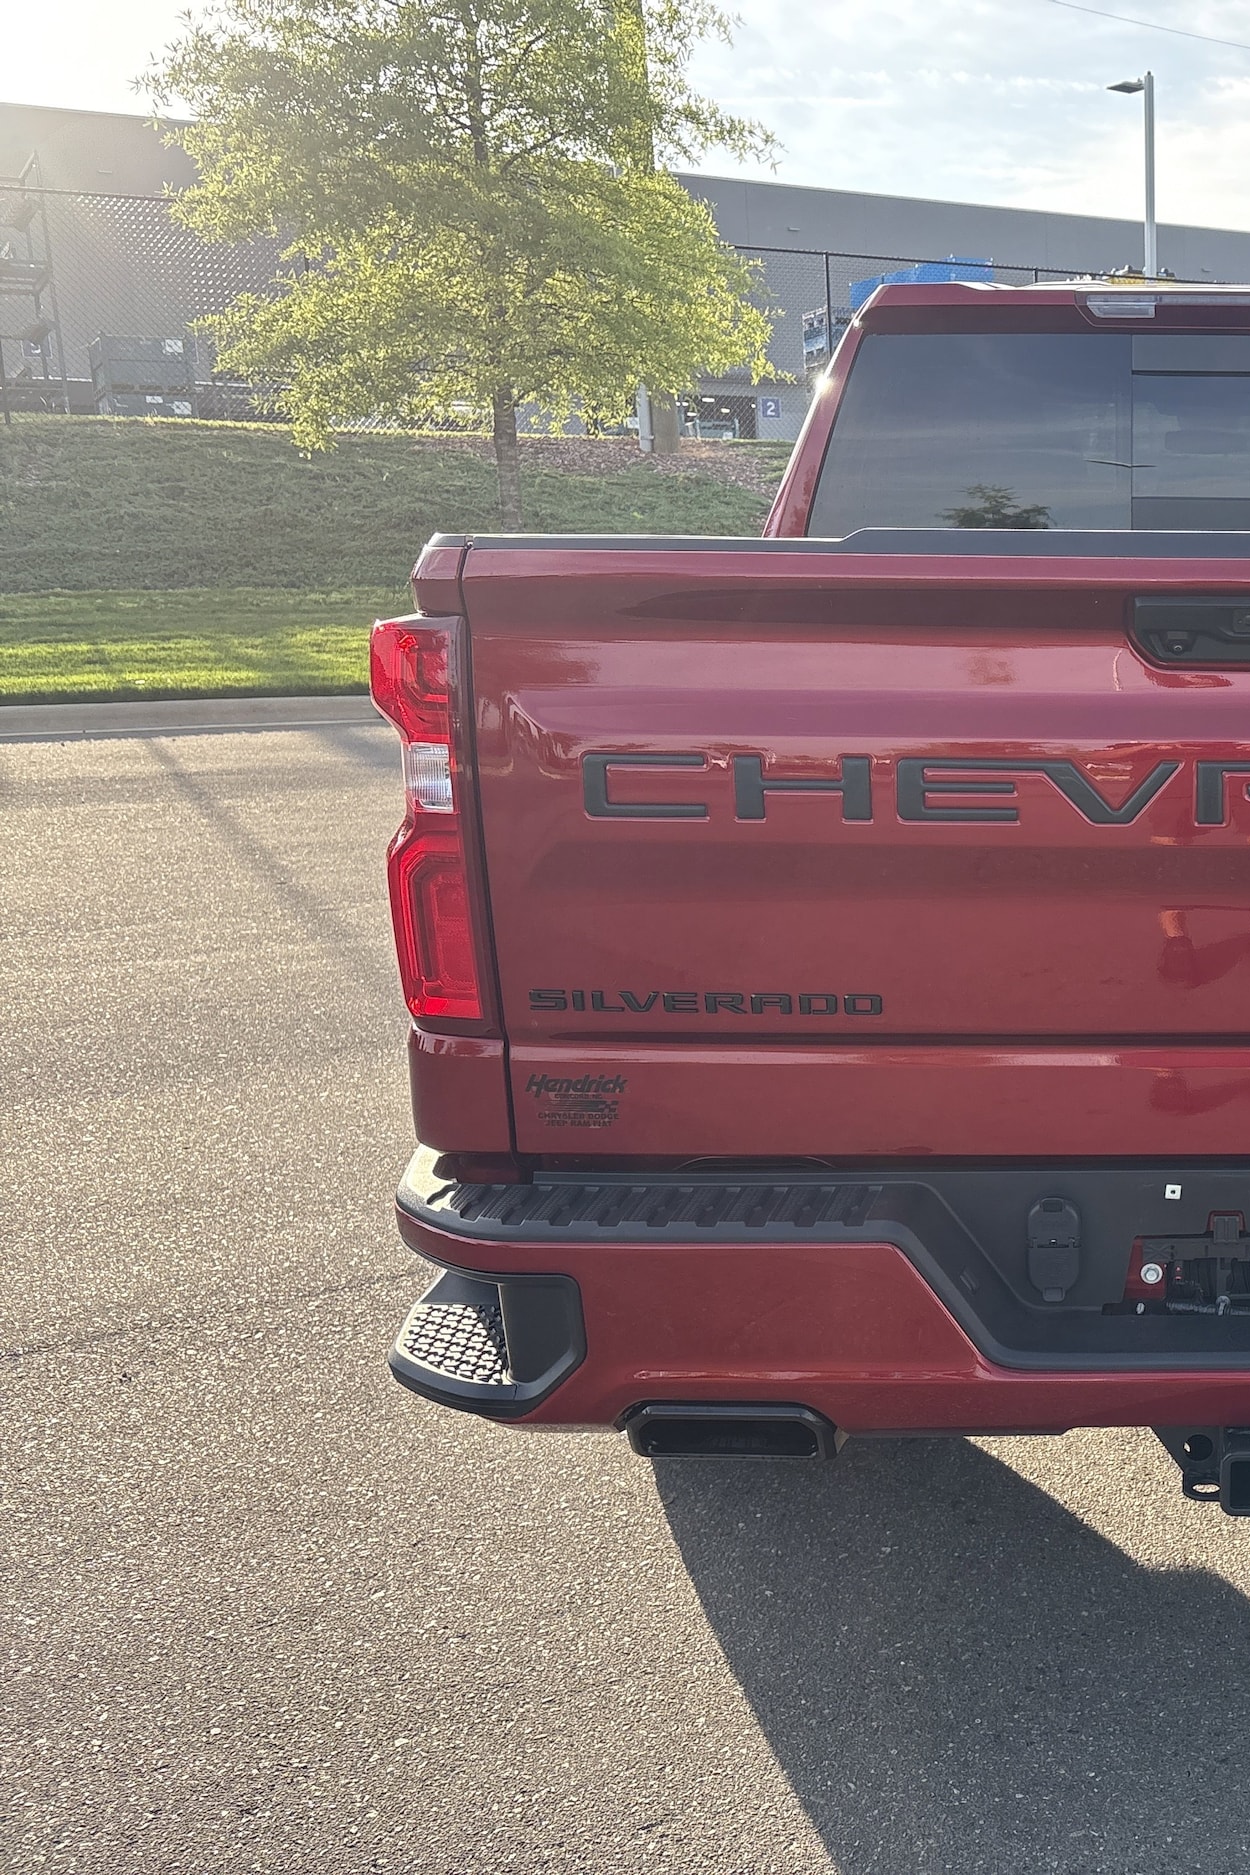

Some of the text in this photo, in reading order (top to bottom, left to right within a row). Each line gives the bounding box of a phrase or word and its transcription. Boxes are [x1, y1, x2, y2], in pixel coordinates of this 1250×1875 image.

[766, 401, 776, 416] 2
[528, 989, 884, 1016] SILVERADO
[525, 1073, 628, 1098] Hendrick
